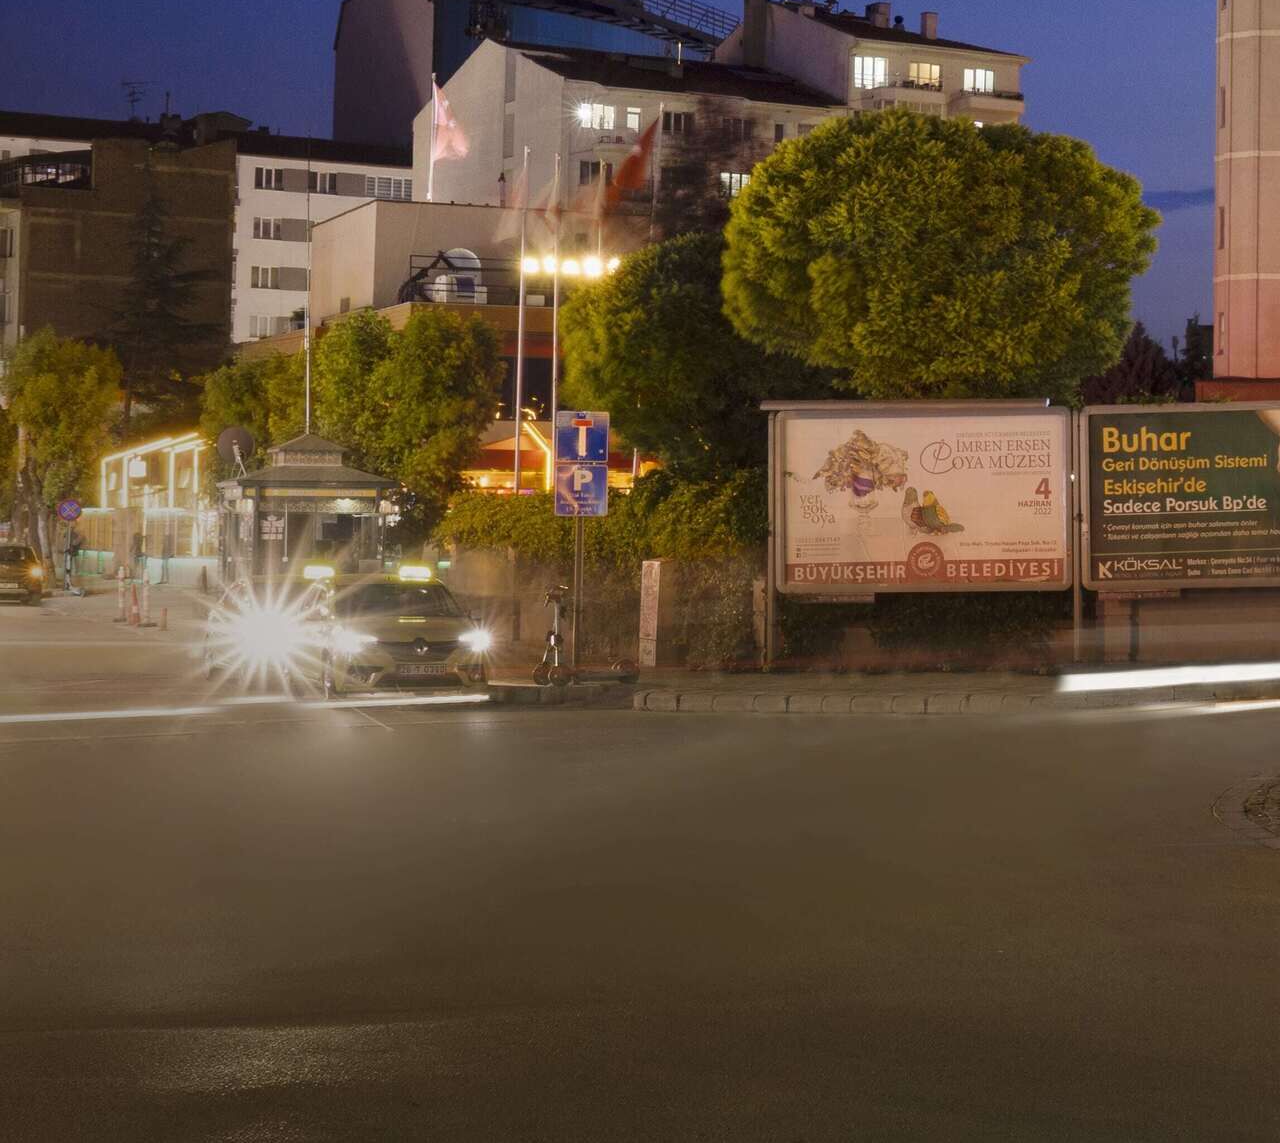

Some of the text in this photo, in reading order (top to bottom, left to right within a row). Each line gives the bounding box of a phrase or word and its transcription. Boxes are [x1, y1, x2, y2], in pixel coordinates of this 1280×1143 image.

[956, 438, 1051, 454] İMREN ERŞEN
[1102, 426, 1192, 453] Buhar
[952, 451, 1052, 469] OYA MÜZESİ
[1102, 454, 1268, 473] Geri Dönüşüm Sistemi
[574, 469, 592, 491] P
[1035, 477, 1052, 500] 4
[1104, 476, 1207, 497] Eskişehir'de
[1018, 499, 1052, 508] HAZİRAN
[1103, 495, 1267, 514] Sadece Porsuk Bp'de
[811, 513, 836, 528] oya
[794, 559, 1059, 582] BÜYÜKŞEHİR BELEDİYESİ
[1114, 557, 1183, 572] KÖKSAL
